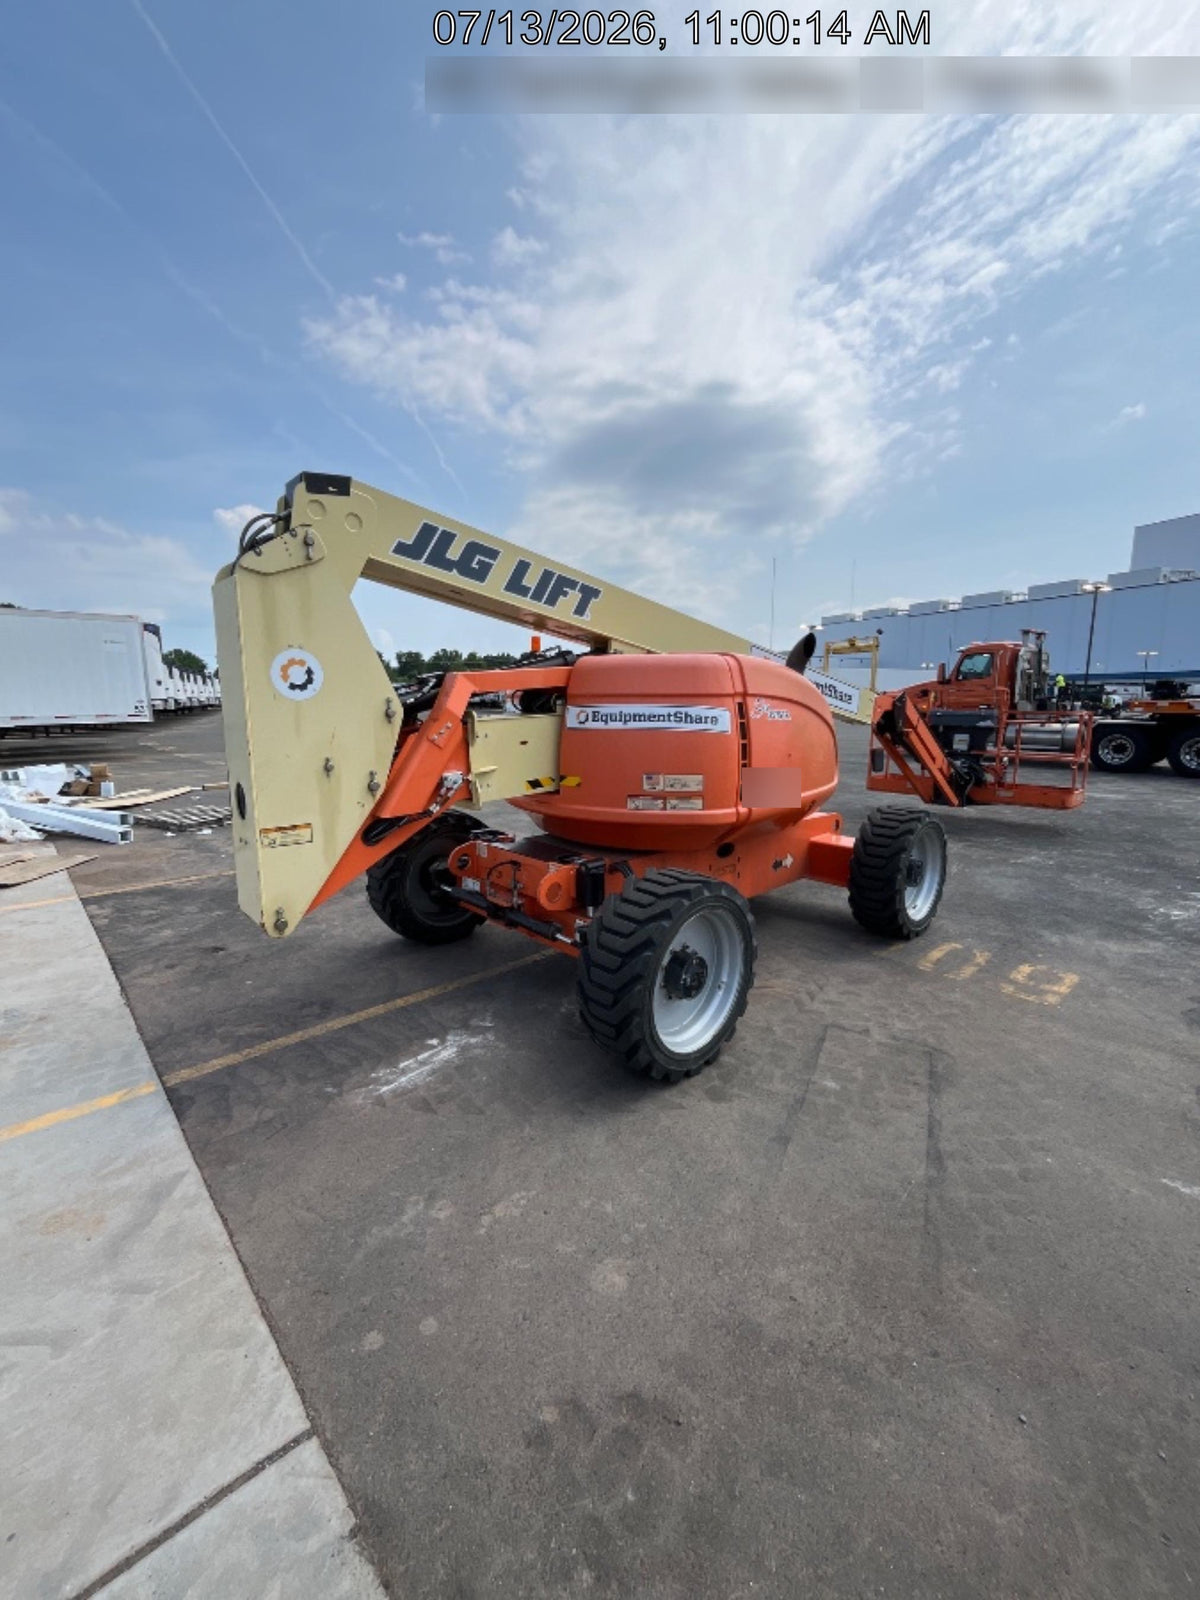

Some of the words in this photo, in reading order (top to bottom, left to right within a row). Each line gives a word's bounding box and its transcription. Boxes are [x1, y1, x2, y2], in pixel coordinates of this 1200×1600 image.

[391, 520, 502, 585] JLG
[503, 558, 602, 620] LIFT
[591, 710, 719, 726] EquipmentShare
